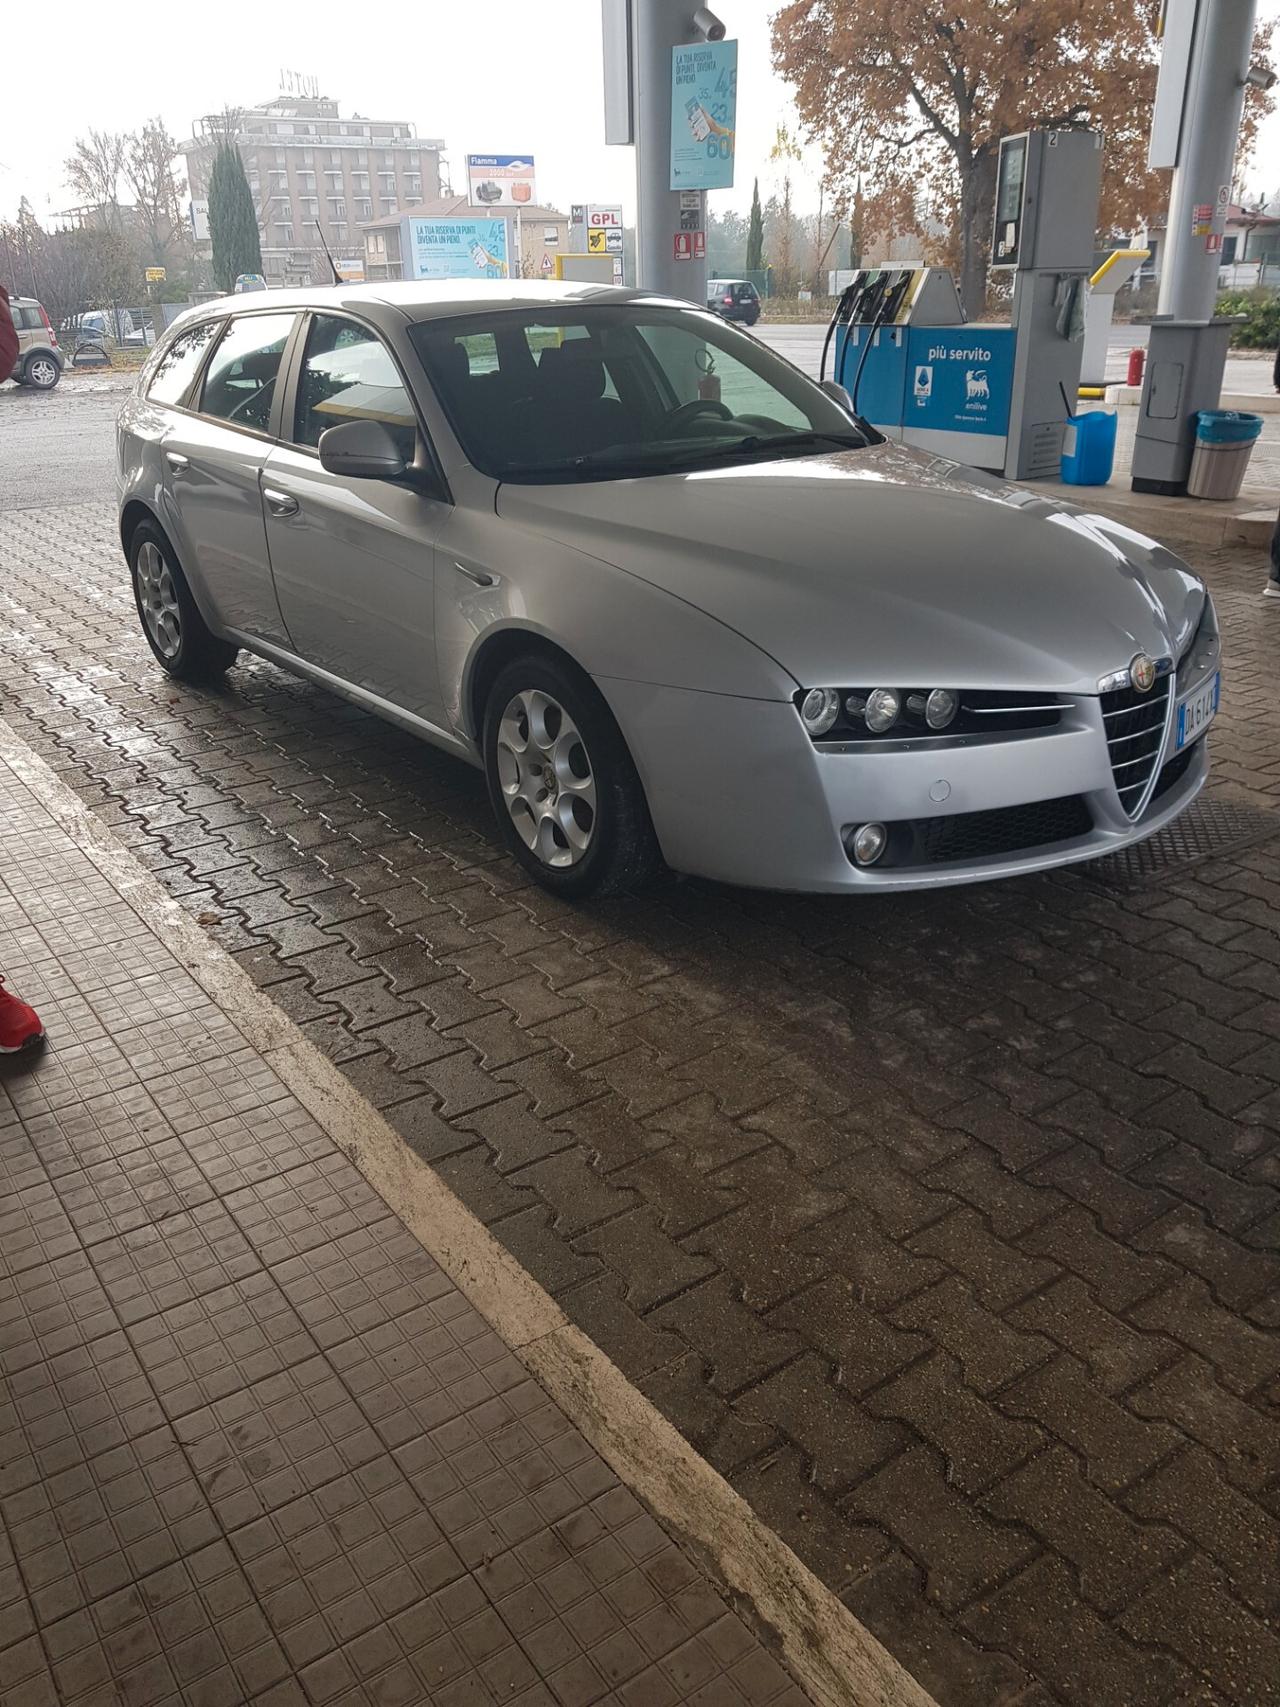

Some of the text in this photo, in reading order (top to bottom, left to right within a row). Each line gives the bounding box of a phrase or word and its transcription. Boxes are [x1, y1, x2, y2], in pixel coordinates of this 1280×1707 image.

[1050, 132, 1057, 145] 2
[471, 157, 498, 165] Fiamma
[591, 213, 619, 225] GPL
[928, 345, 991, 362] più servito
